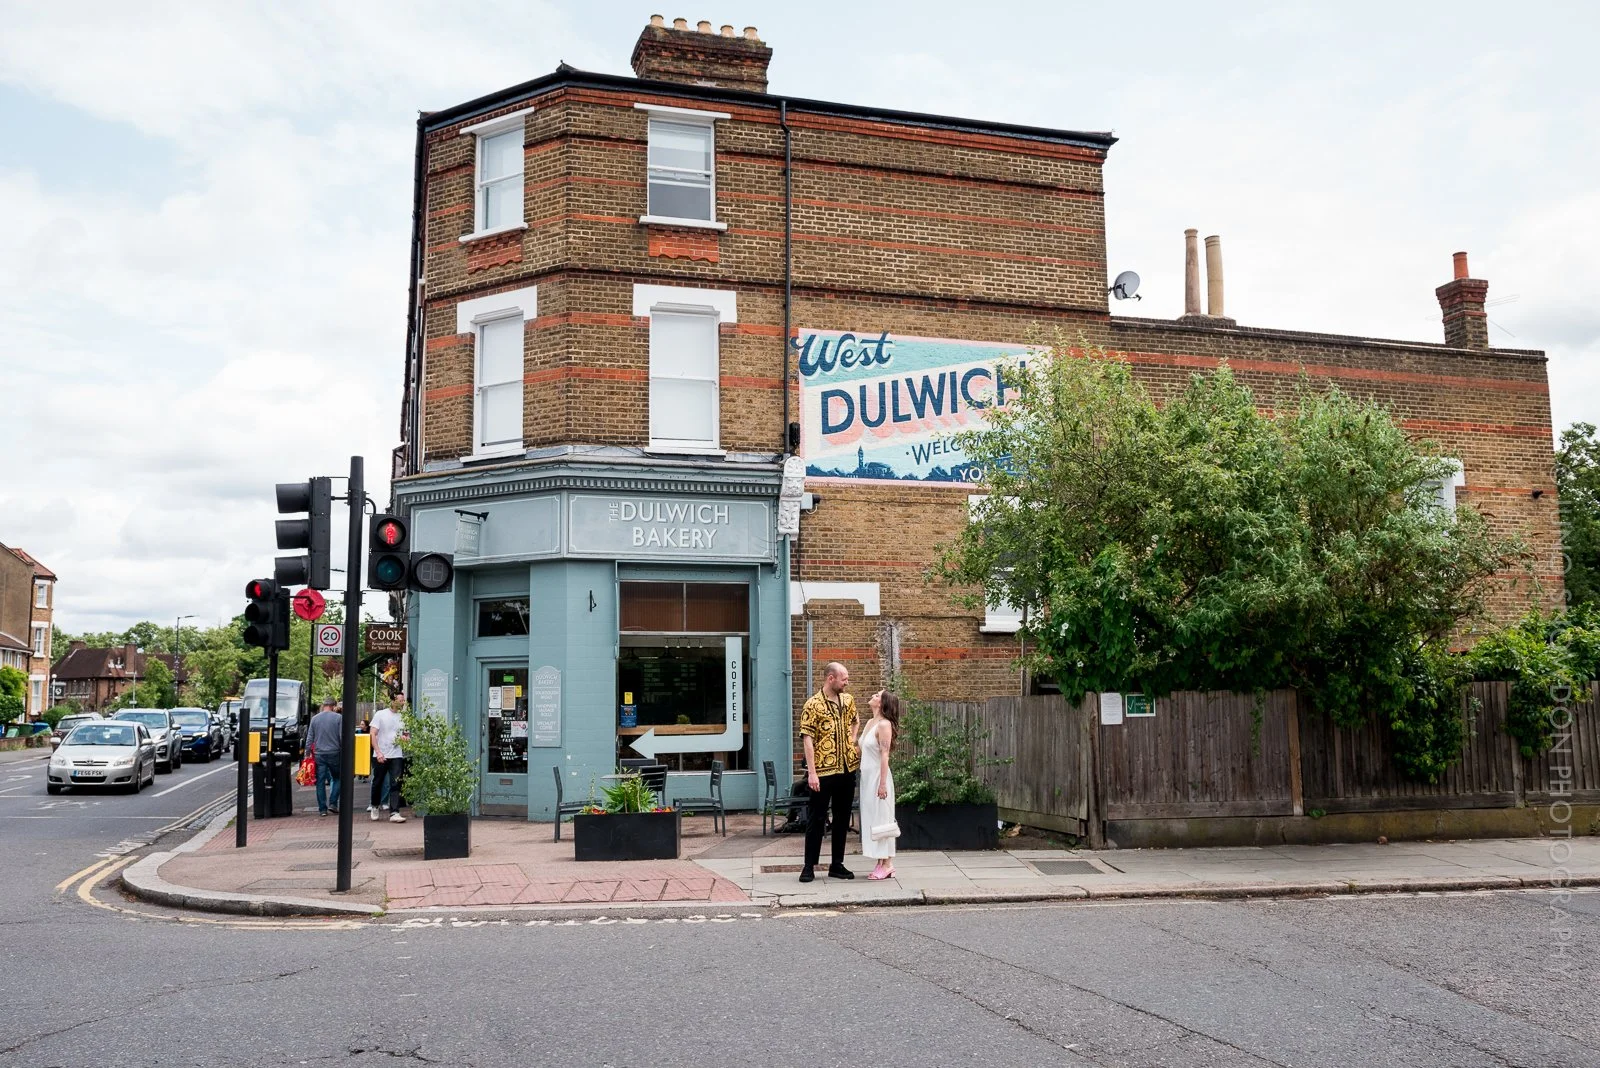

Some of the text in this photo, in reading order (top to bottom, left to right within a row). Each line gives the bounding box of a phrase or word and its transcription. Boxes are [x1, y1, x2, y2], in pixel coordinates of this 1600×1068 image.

[791, 331, 893, 377] West
[821, 360, 1027, 435] DULWICH
[609, 501, 730, 525] THE DULWICH
[632, 526, 718, 549] BAKERY
[323, 631, 338, 641] 20
[369, 629, 403, 641] COOK
